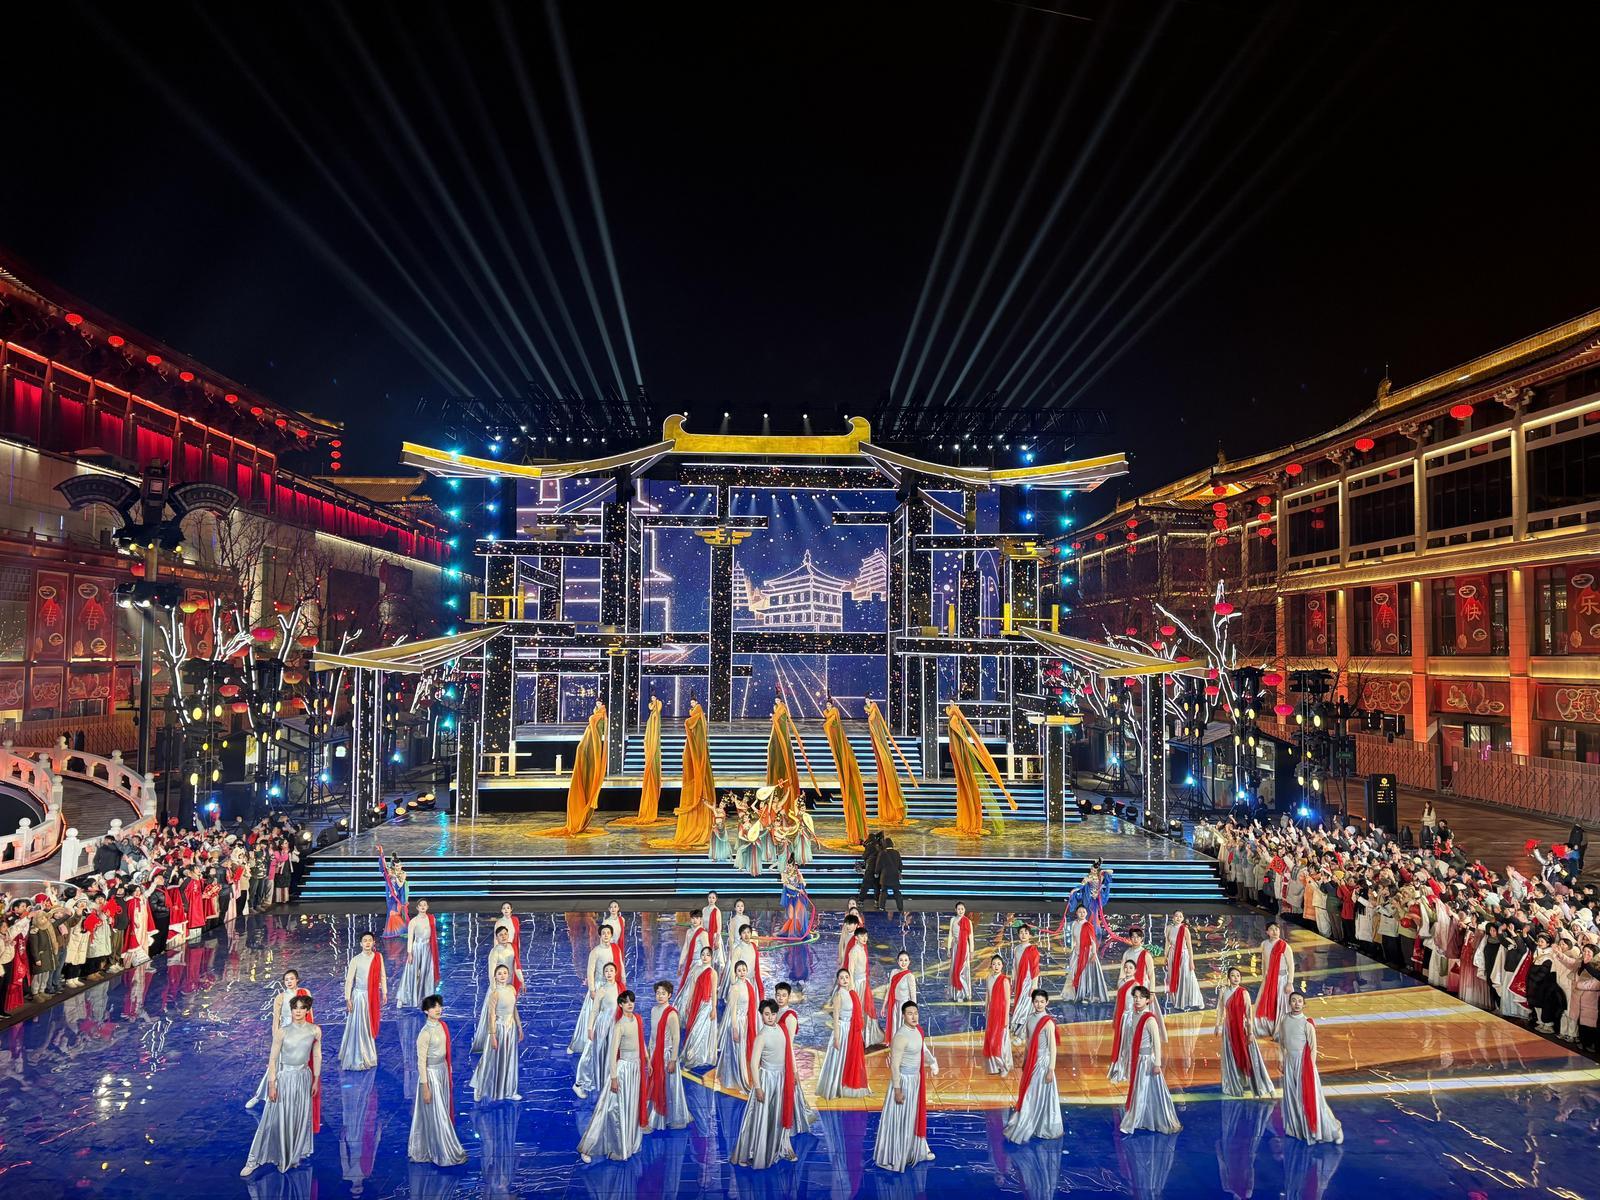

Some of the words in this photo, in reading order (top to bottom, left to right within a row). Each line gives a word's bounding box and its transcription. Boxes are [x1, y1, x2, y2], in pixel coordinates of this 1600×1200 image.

[44, 605, 57, 627] 春
[1465, 603, 1482, 622] 快
[1580, 595, 1600, 616] 乐
[84, 605, 100, 631] 春
[1380, 609, 1392, 629] 春
